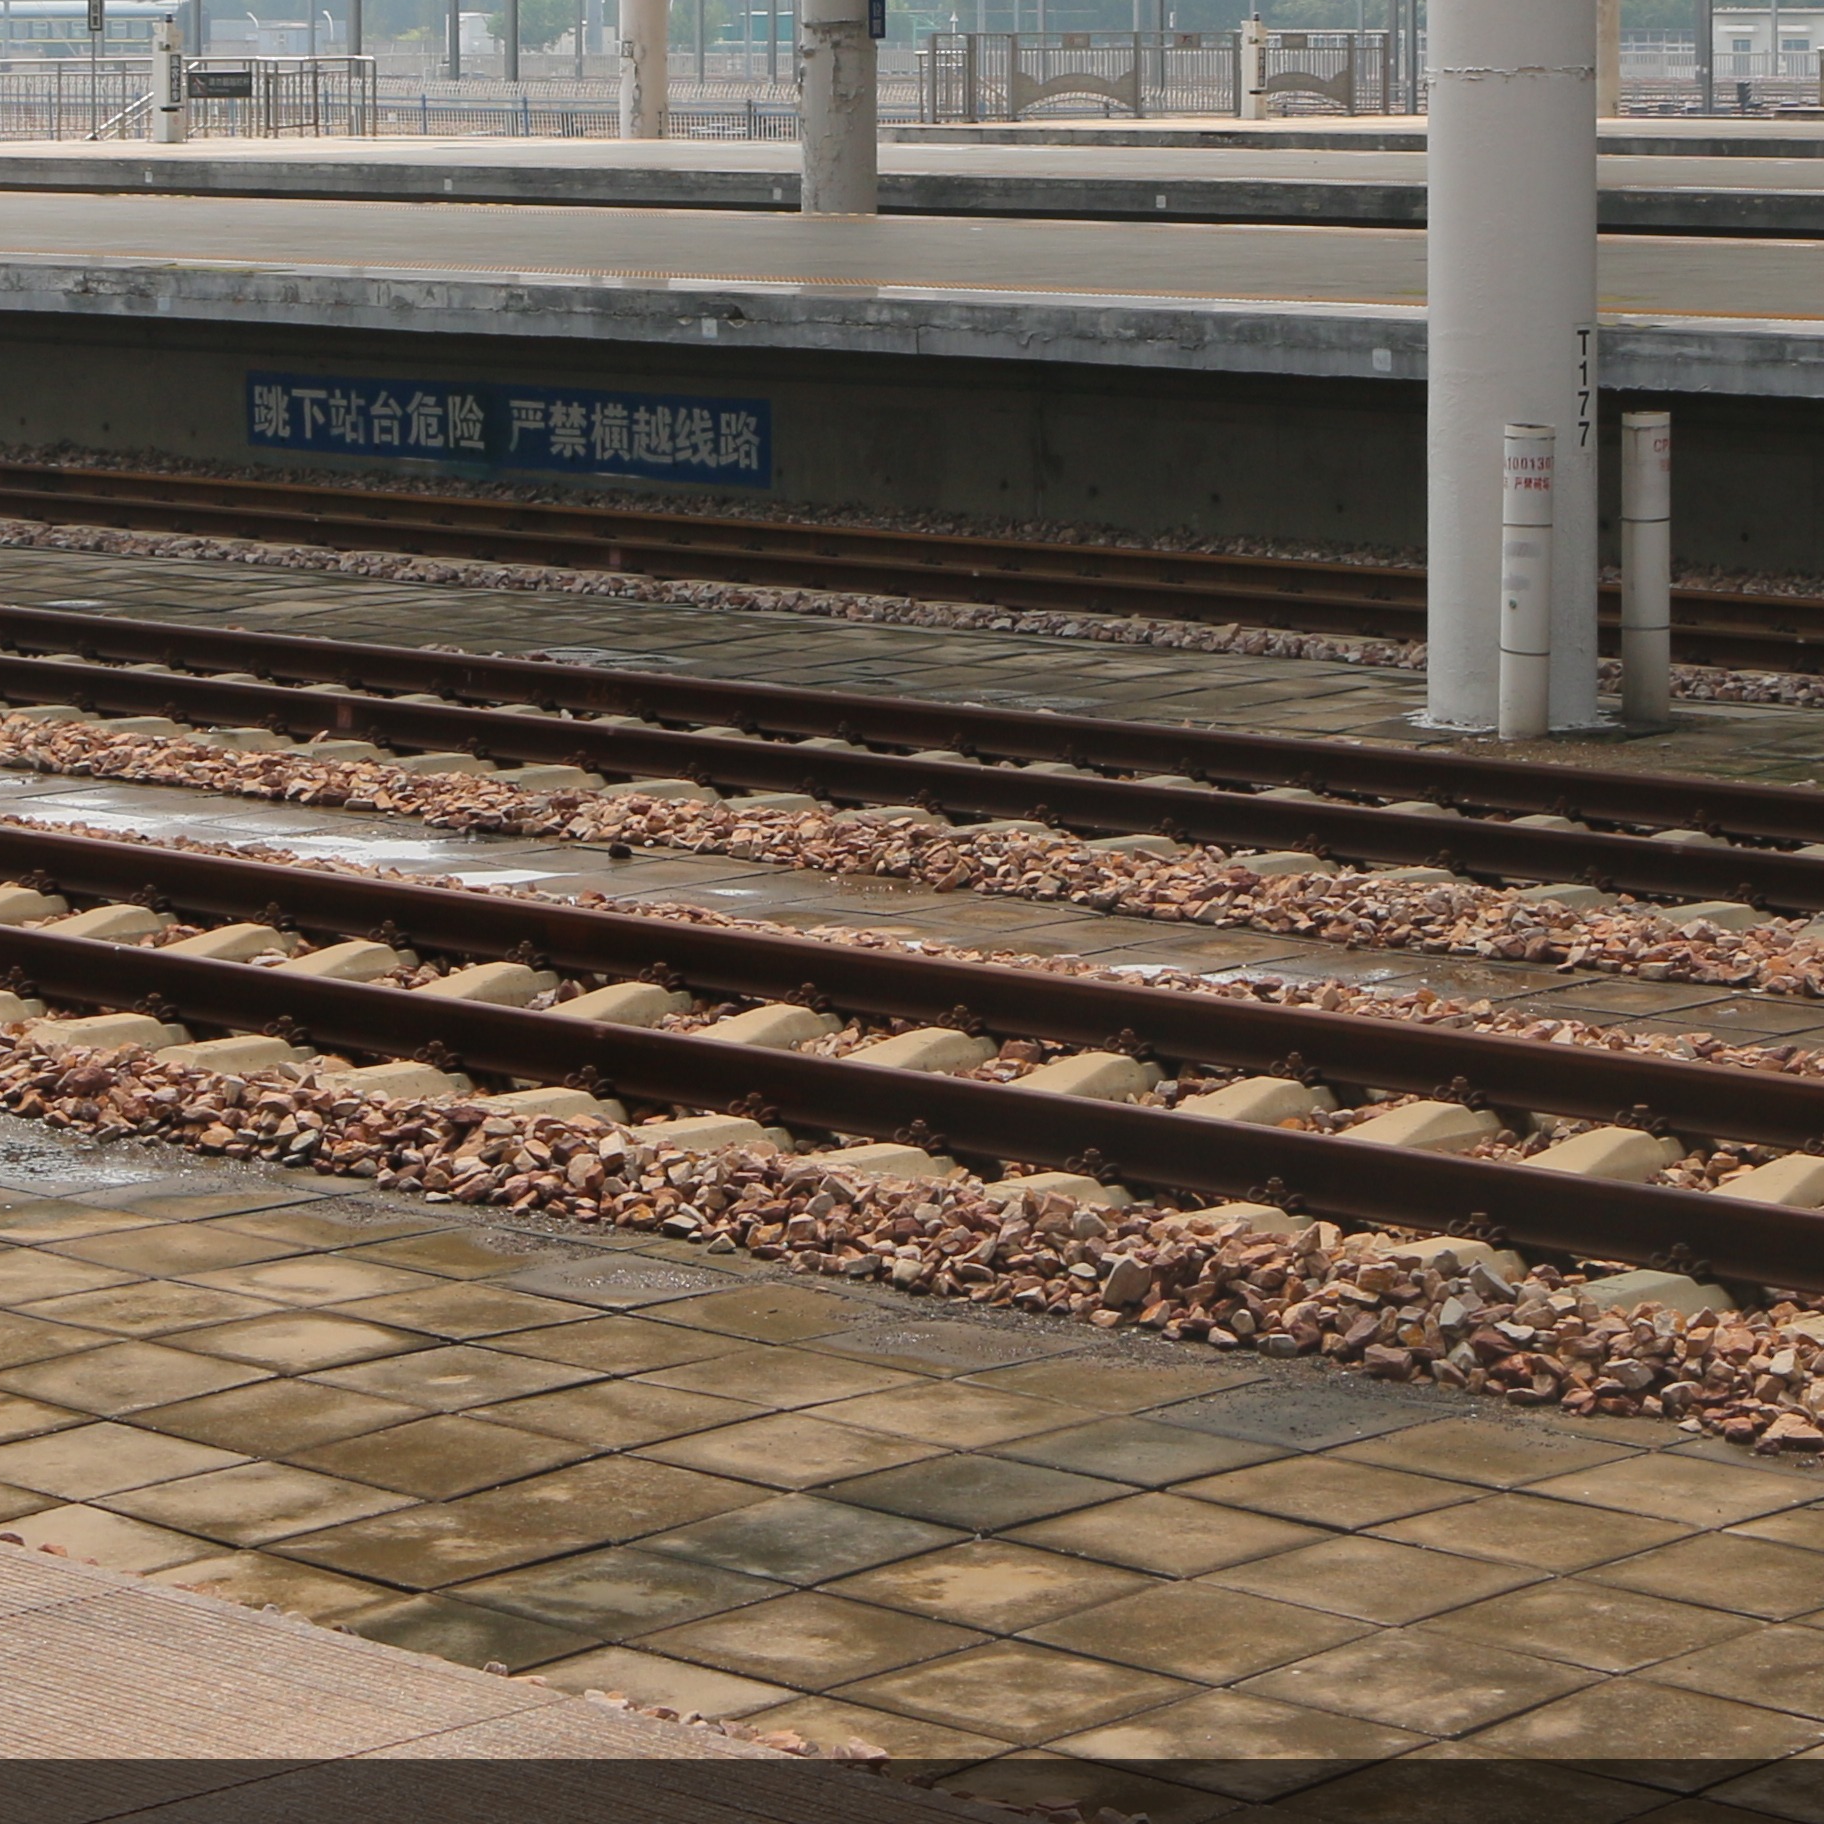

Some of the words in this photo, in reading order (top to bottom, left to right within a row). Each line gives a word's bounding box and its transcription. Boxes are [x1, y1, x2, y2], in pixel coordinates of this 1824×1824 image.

[253, 384, 486, 450] 跳下站台危险
[509, 398, 762, 471] 严禁横越线路
[1577, 330, 1591, 448] T177
